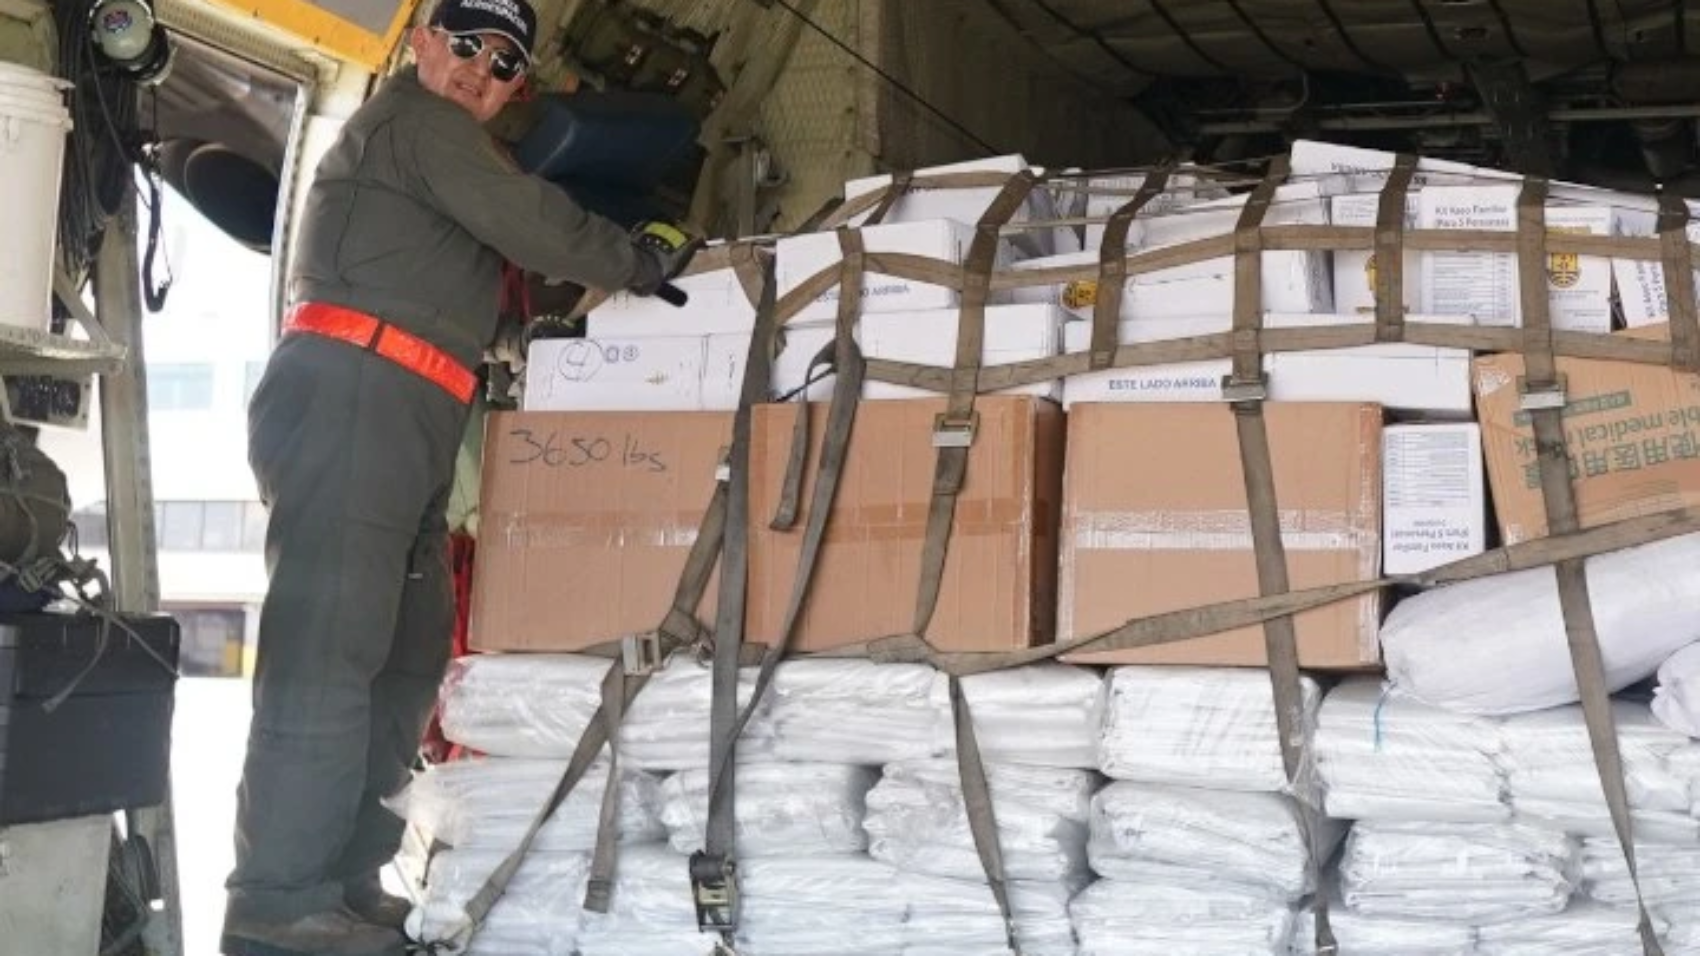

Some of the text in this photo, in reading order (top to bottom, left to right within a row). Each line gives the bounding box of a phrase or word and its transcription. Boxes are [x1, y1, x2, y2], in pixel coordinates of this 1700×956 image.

[1109, 378, 1216, 390] ESTE LADO ARRIBA
[509, 428, 610, 466] 3650
[1579, 413, 1663, 448] medical
